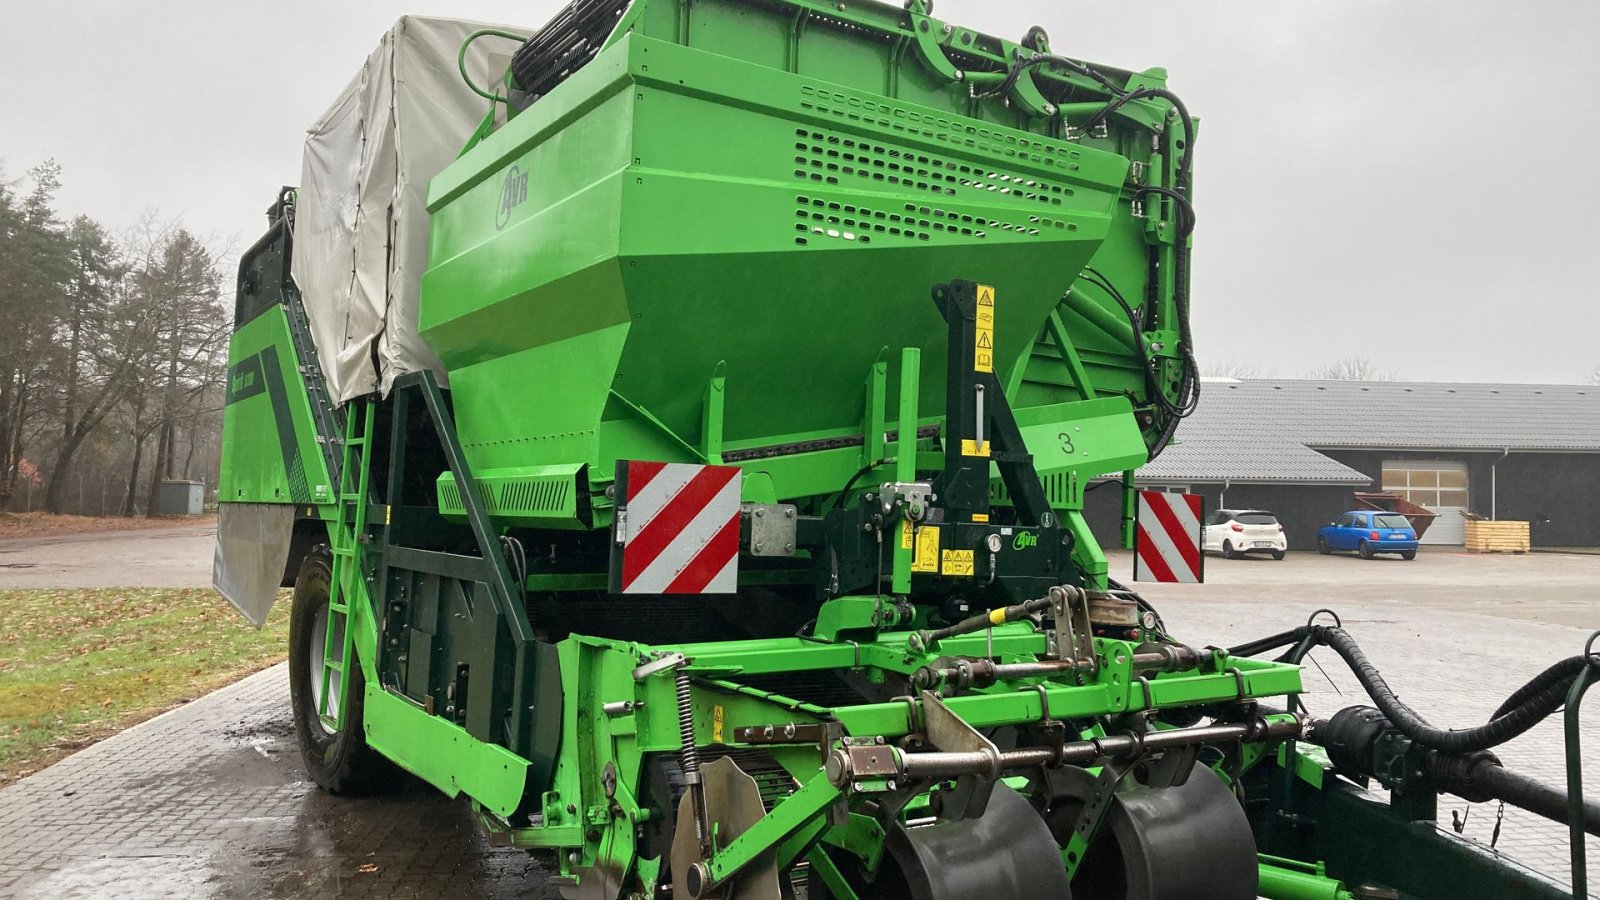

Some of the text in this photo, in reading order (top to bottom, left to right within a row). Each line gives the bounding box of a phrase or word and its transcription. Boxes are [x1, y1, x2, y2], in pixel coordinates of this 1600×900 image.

[496, 165, 529, 231] AVR
[1058, 432, 1075, 454] 3
[1013, 531, 1038, 550] AVR
